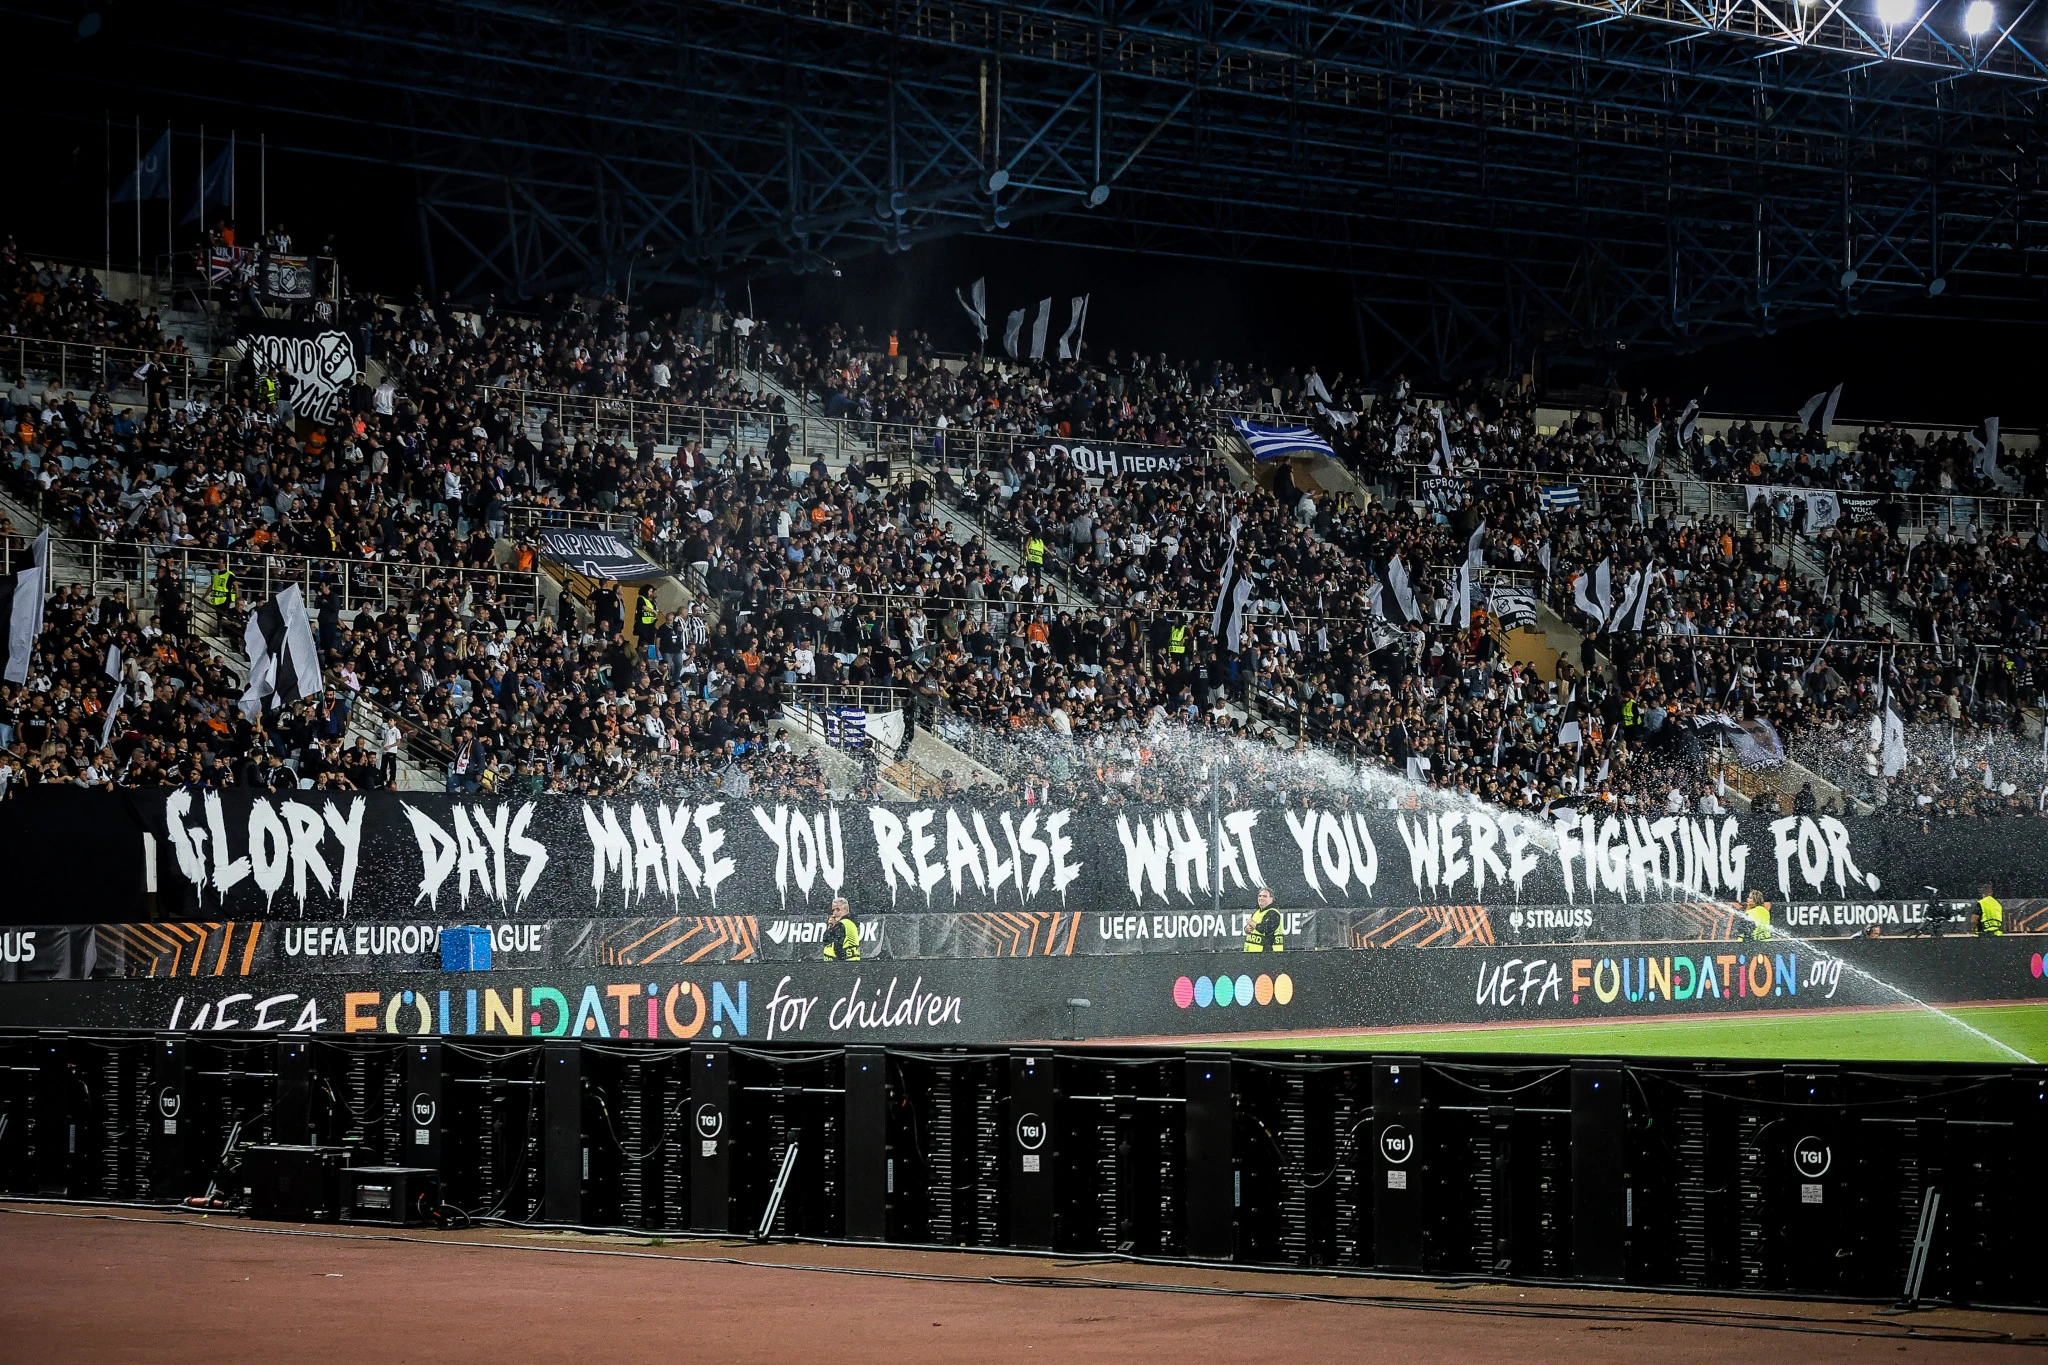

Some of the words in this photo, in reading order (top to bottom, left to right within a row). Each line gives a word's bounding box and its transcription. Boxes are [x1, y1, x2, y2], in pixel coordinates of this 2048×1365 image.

[166, 785, 366, 919] GLORY
[400, 800, 550, 914] DAYS
[582, 799, 737, 914] MAKE
[750, 802, 845, 910] YOU
[868, 805, 1084, 908] REALISE
[1115, 806, 1268, 906] WHAT
[1284, 808, 1378, 903] YOU
[1398, 810, 1540, 903] WERE
[1553, 812, 1751, 904] FIGHTING
[1768, 814, 1881, 903] FOR.
[1526, 908, 1593, 930] STRAUSS
[1786, 906, 1831, 927] UEFA
[1833, 903, 1899, 925] EUROPA
[1100, 916, 1150, 941] UEFA
[1153, 914, 1227, 939] EUROPA
[0, 931, 36, 962] US
[284, 924, 349, 957] UEFA
[1476, 958, 1563, 1006] UEFA
[1571, 952, 1797, 1006] FOUNDATION
[344, 979, 750, 1040] FOUNDATION
[765, 975, 819, 1041] for
[828, 975, 963, 1031] children
[162, 1097, 176, 1108] TGI
[416, 1104, 430, 1115] TGI
[700, 1115, 717, 1127] TGI
[1021, 1126, 1040, 1138] TGI
[1386, 1138, 1406, 1151] TGI
[1800, 1150, 1822, 1164] TGI
